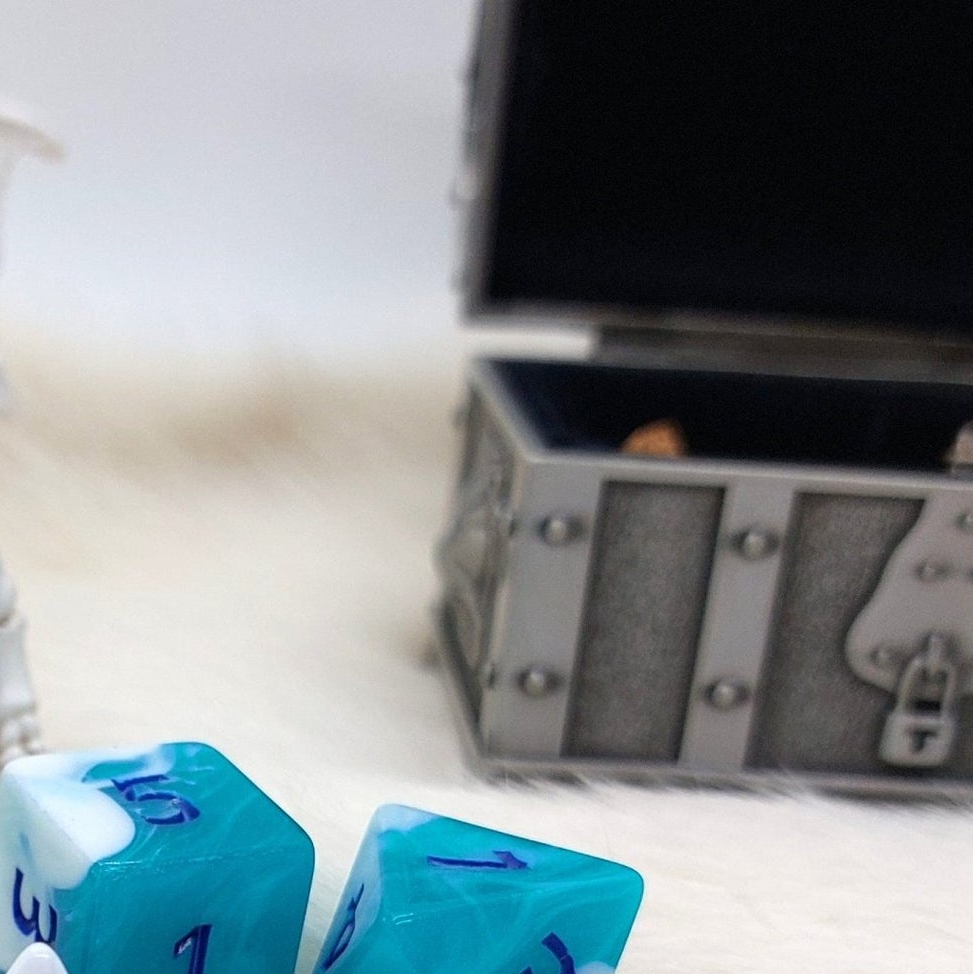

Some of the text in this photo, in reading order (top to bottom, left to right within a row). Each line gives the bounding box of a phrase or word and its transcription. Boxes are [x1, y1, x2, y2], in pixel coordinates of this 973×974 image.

[112, 774, 201, 826] 5
[427, 850, 529, 871] 1
[12, 867, 58, 945] 3
